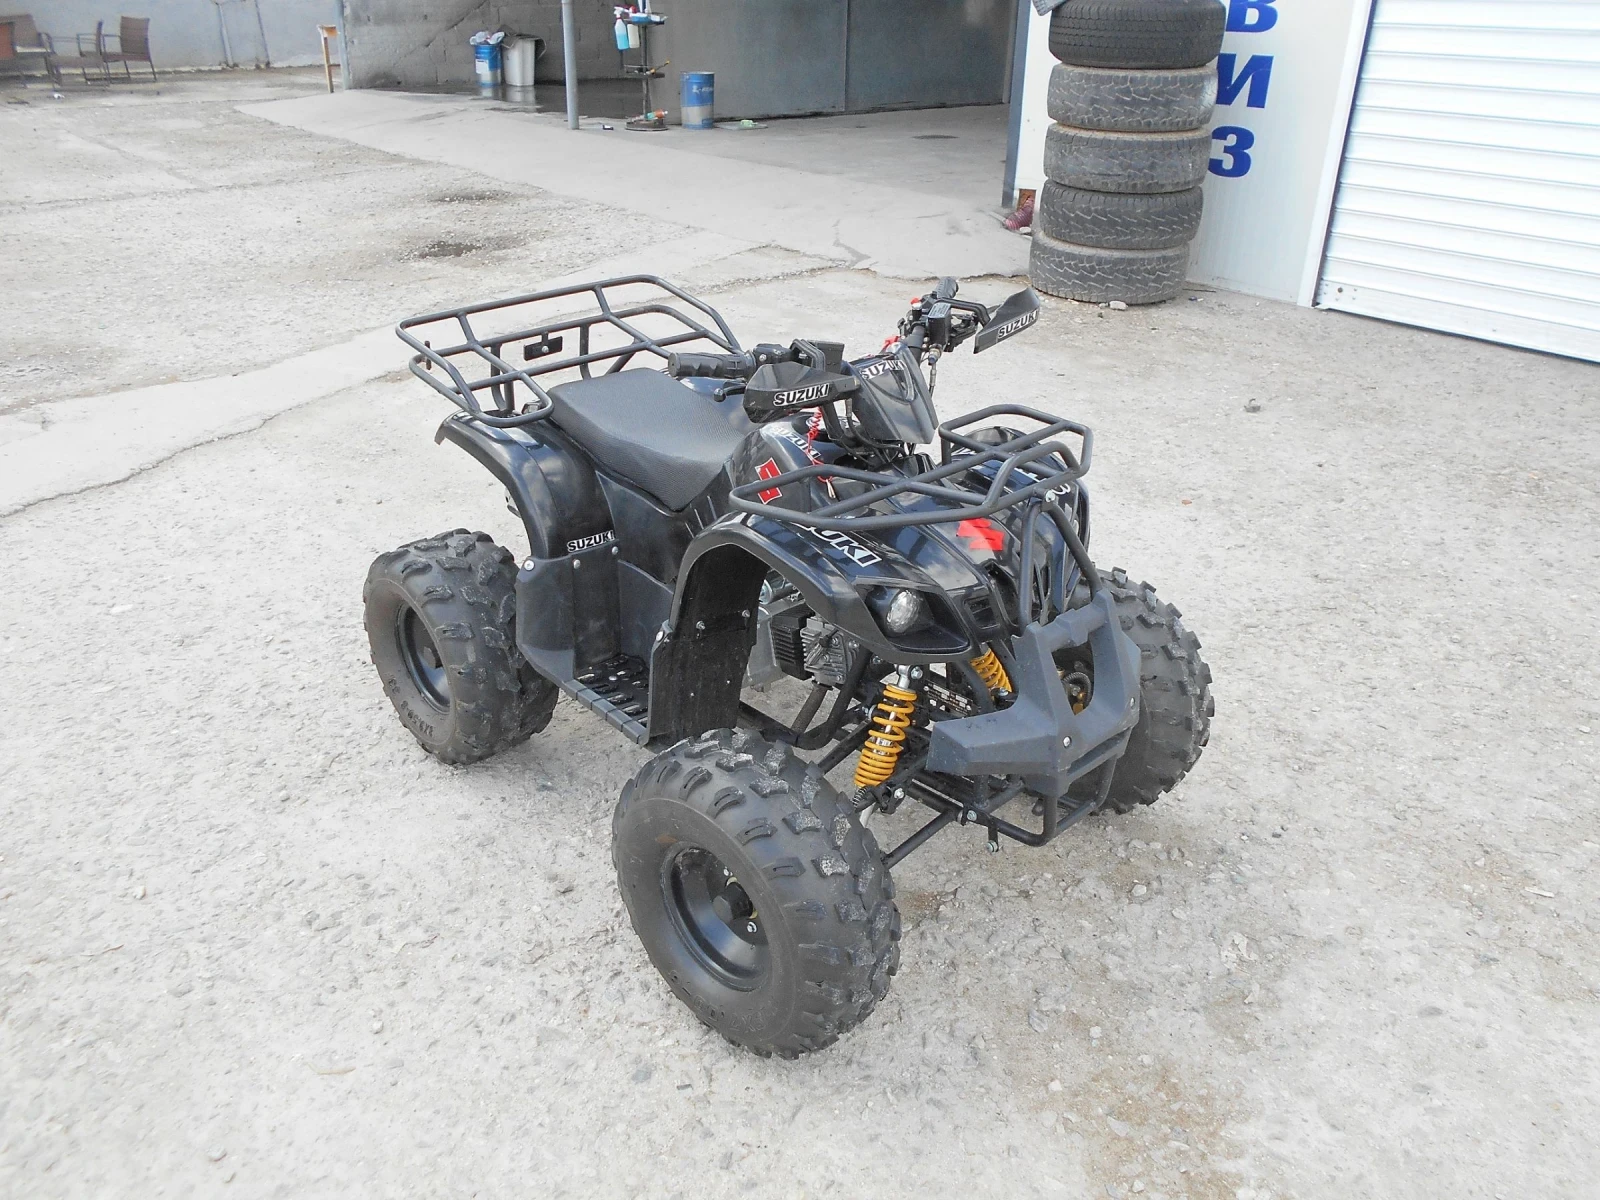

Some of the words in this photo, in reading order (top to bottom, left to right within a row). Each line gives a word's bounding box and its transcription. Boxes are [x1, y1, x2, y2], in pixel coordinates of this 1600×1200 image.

[997, 309, 1039, 339] SUZUKI
[860, 360, 905, 380] SUZUKI
[773, 383, 830, 407] SUZUKI
[566, 529, 616, 553] SUZUKI
